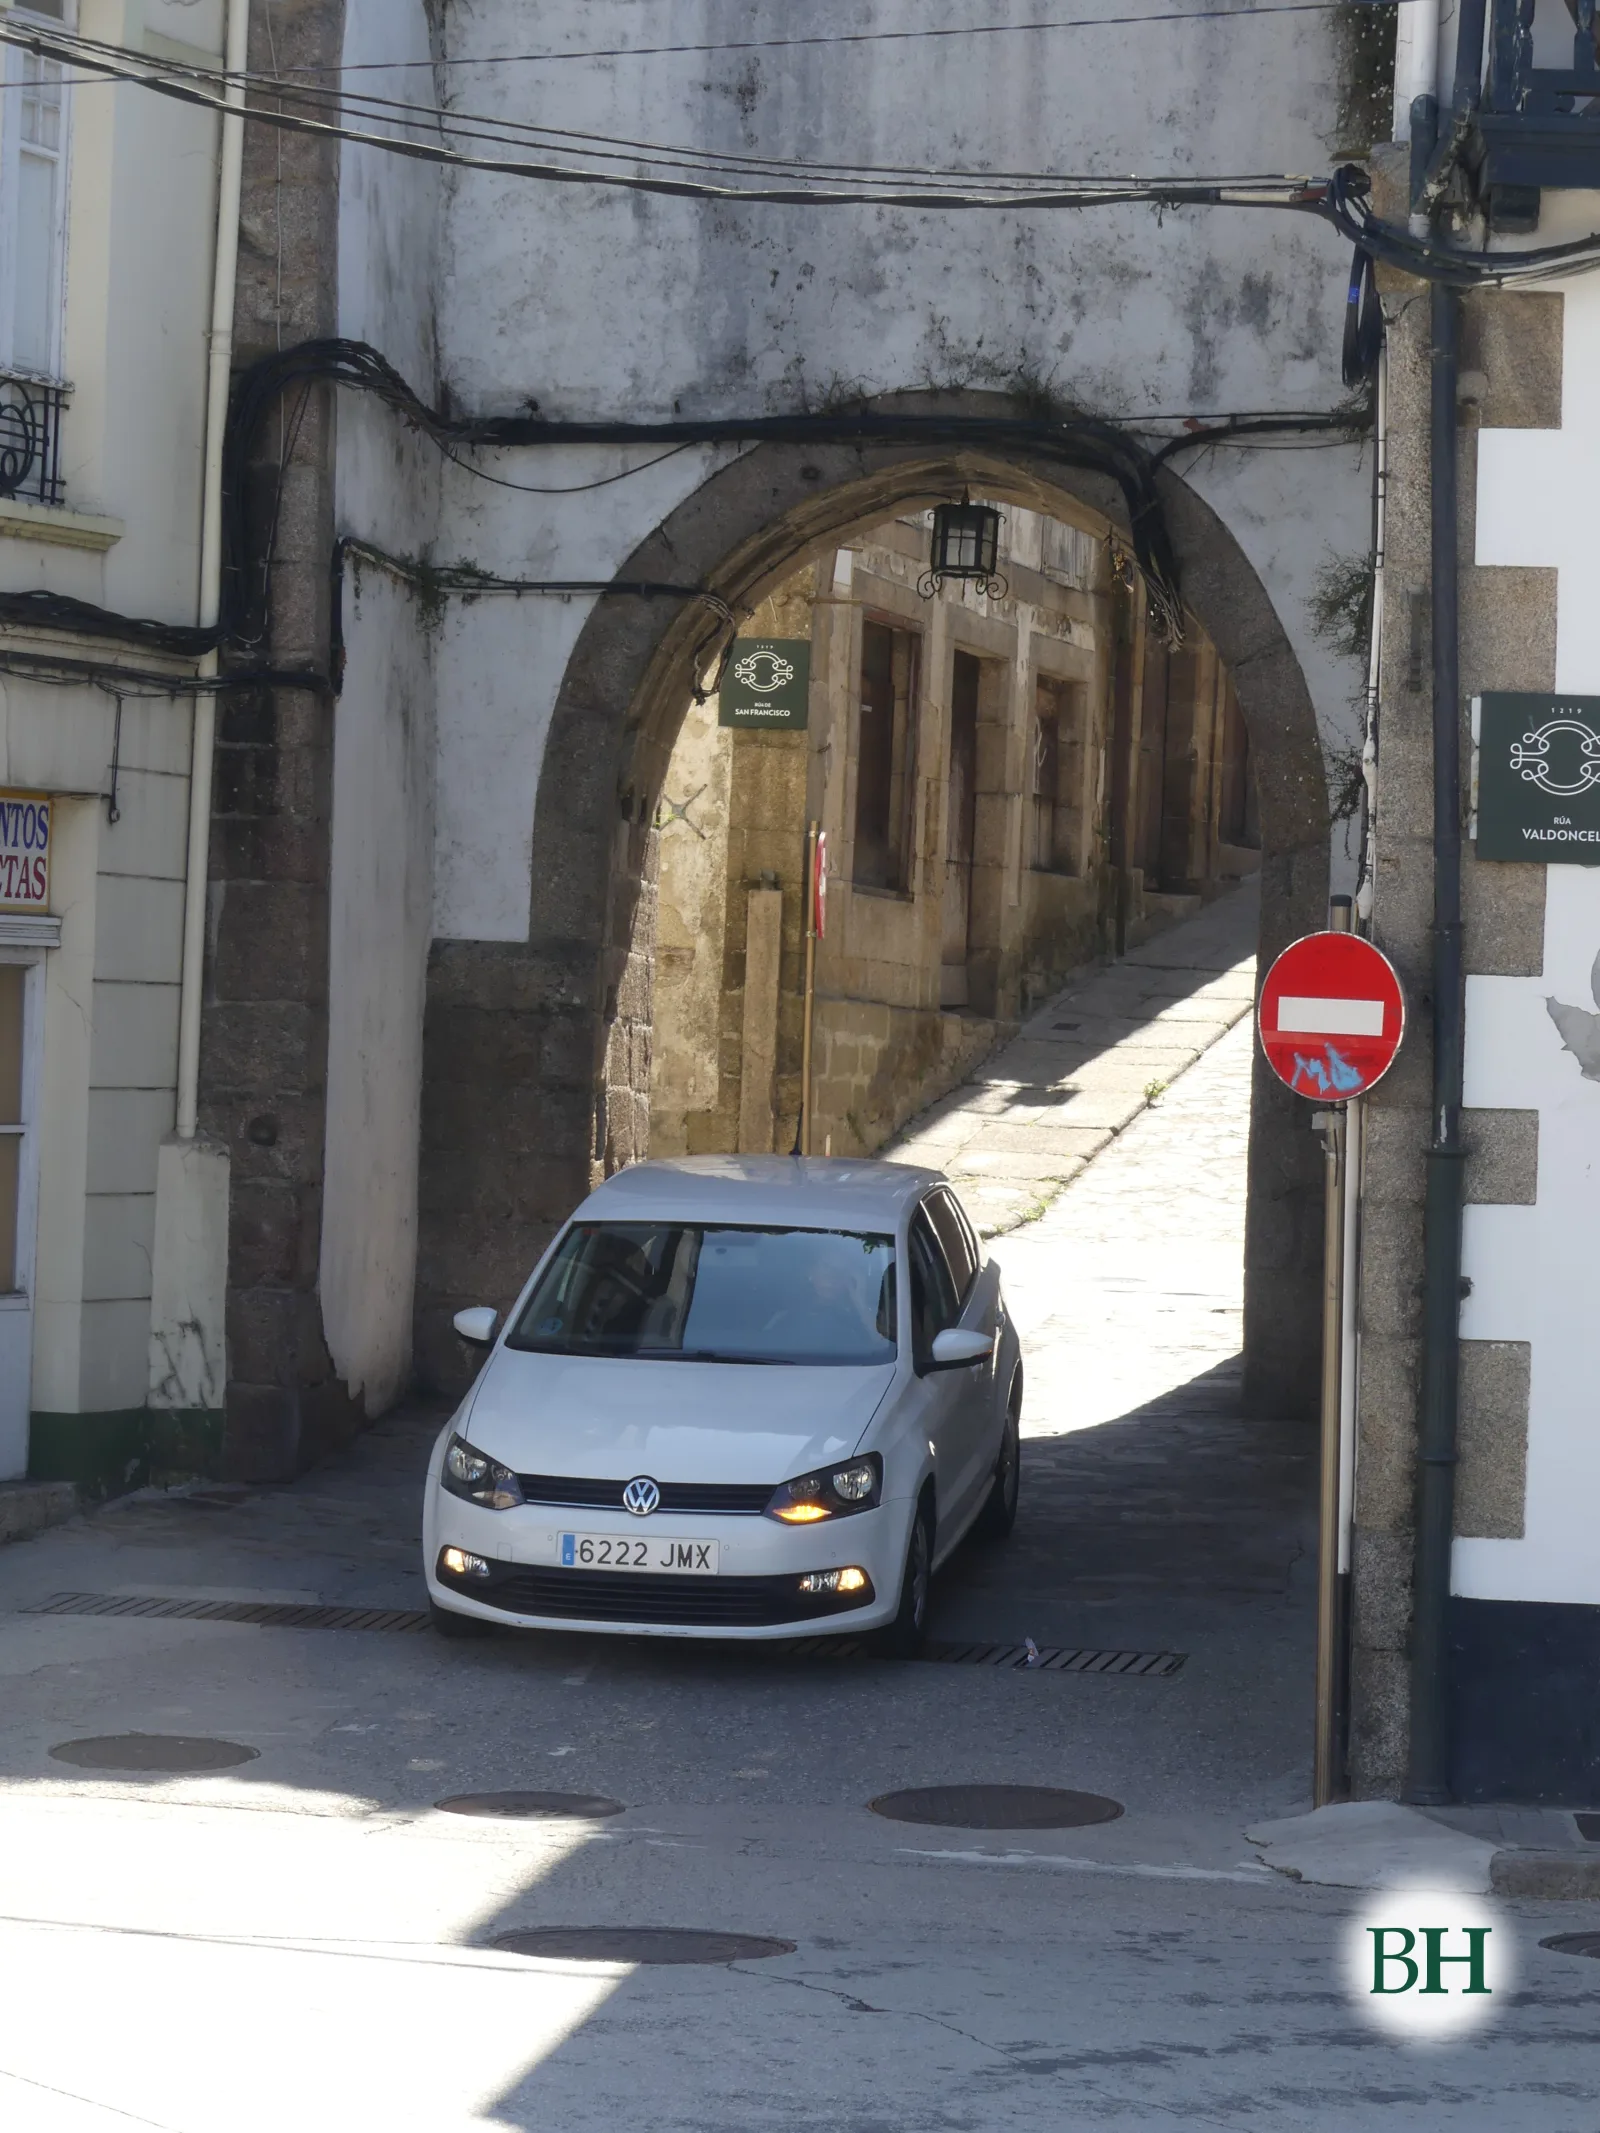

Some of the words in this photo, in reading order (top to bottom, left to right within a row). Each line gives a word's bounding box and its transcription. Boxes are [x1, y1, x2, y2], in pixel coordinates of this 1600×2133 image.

[735, 708, 750, 716] SAN
[750, 709, 791, 717] FRANCISCO
[1553, 815, 1572, 825] RÚA
[1522, 828, 1600, 842] VALDONCEL
[0, 854, 47, 900] TAS
[579, 1539, 648, 1566] 6222
[660, 1543, 711, 1569] JMX
